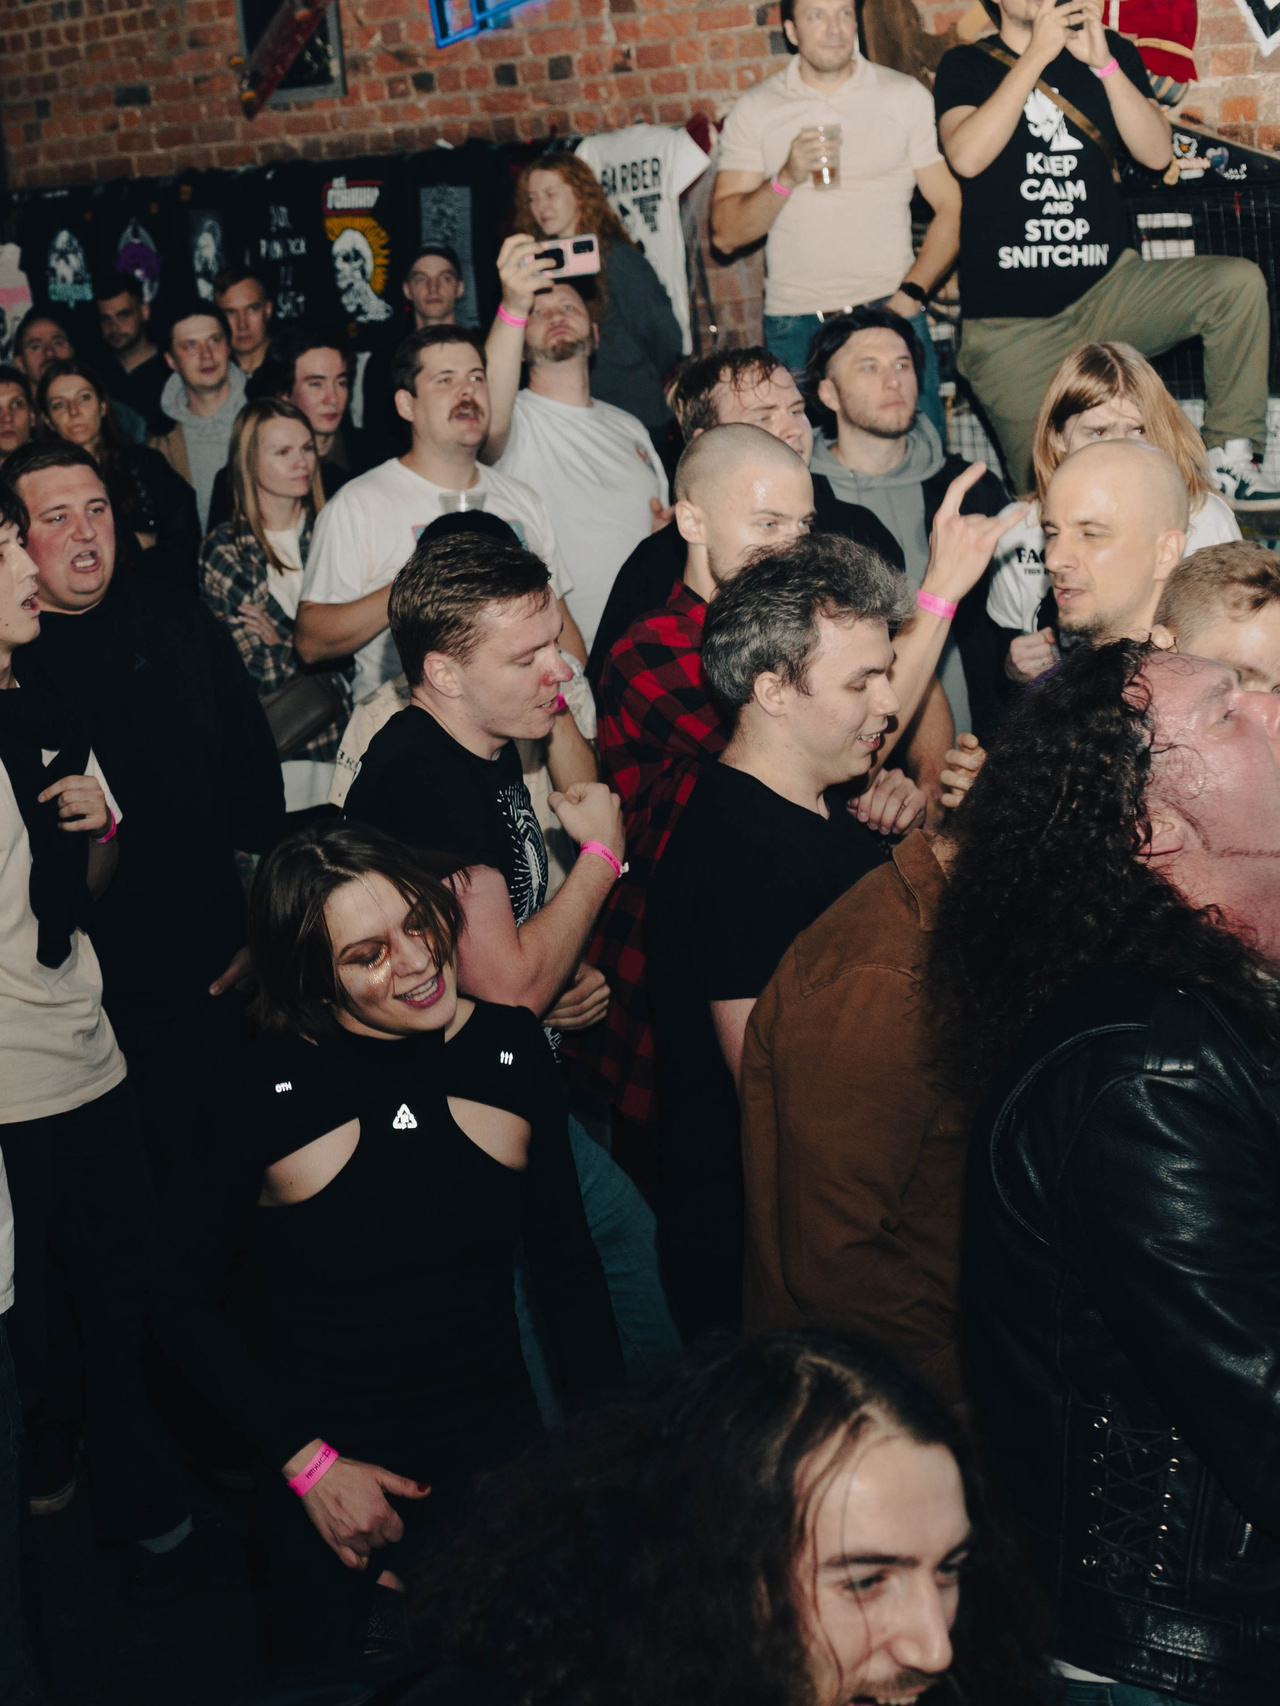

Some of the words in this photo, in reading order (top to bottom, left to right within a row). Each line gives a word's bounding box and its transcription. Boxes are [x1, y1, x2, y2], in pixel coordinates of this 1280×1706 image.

[1042, 201, 1074, 215] AND
[1025, 218, 1090, 241] STOP
[998, 244, 1109, 269] SNITCHIN'
